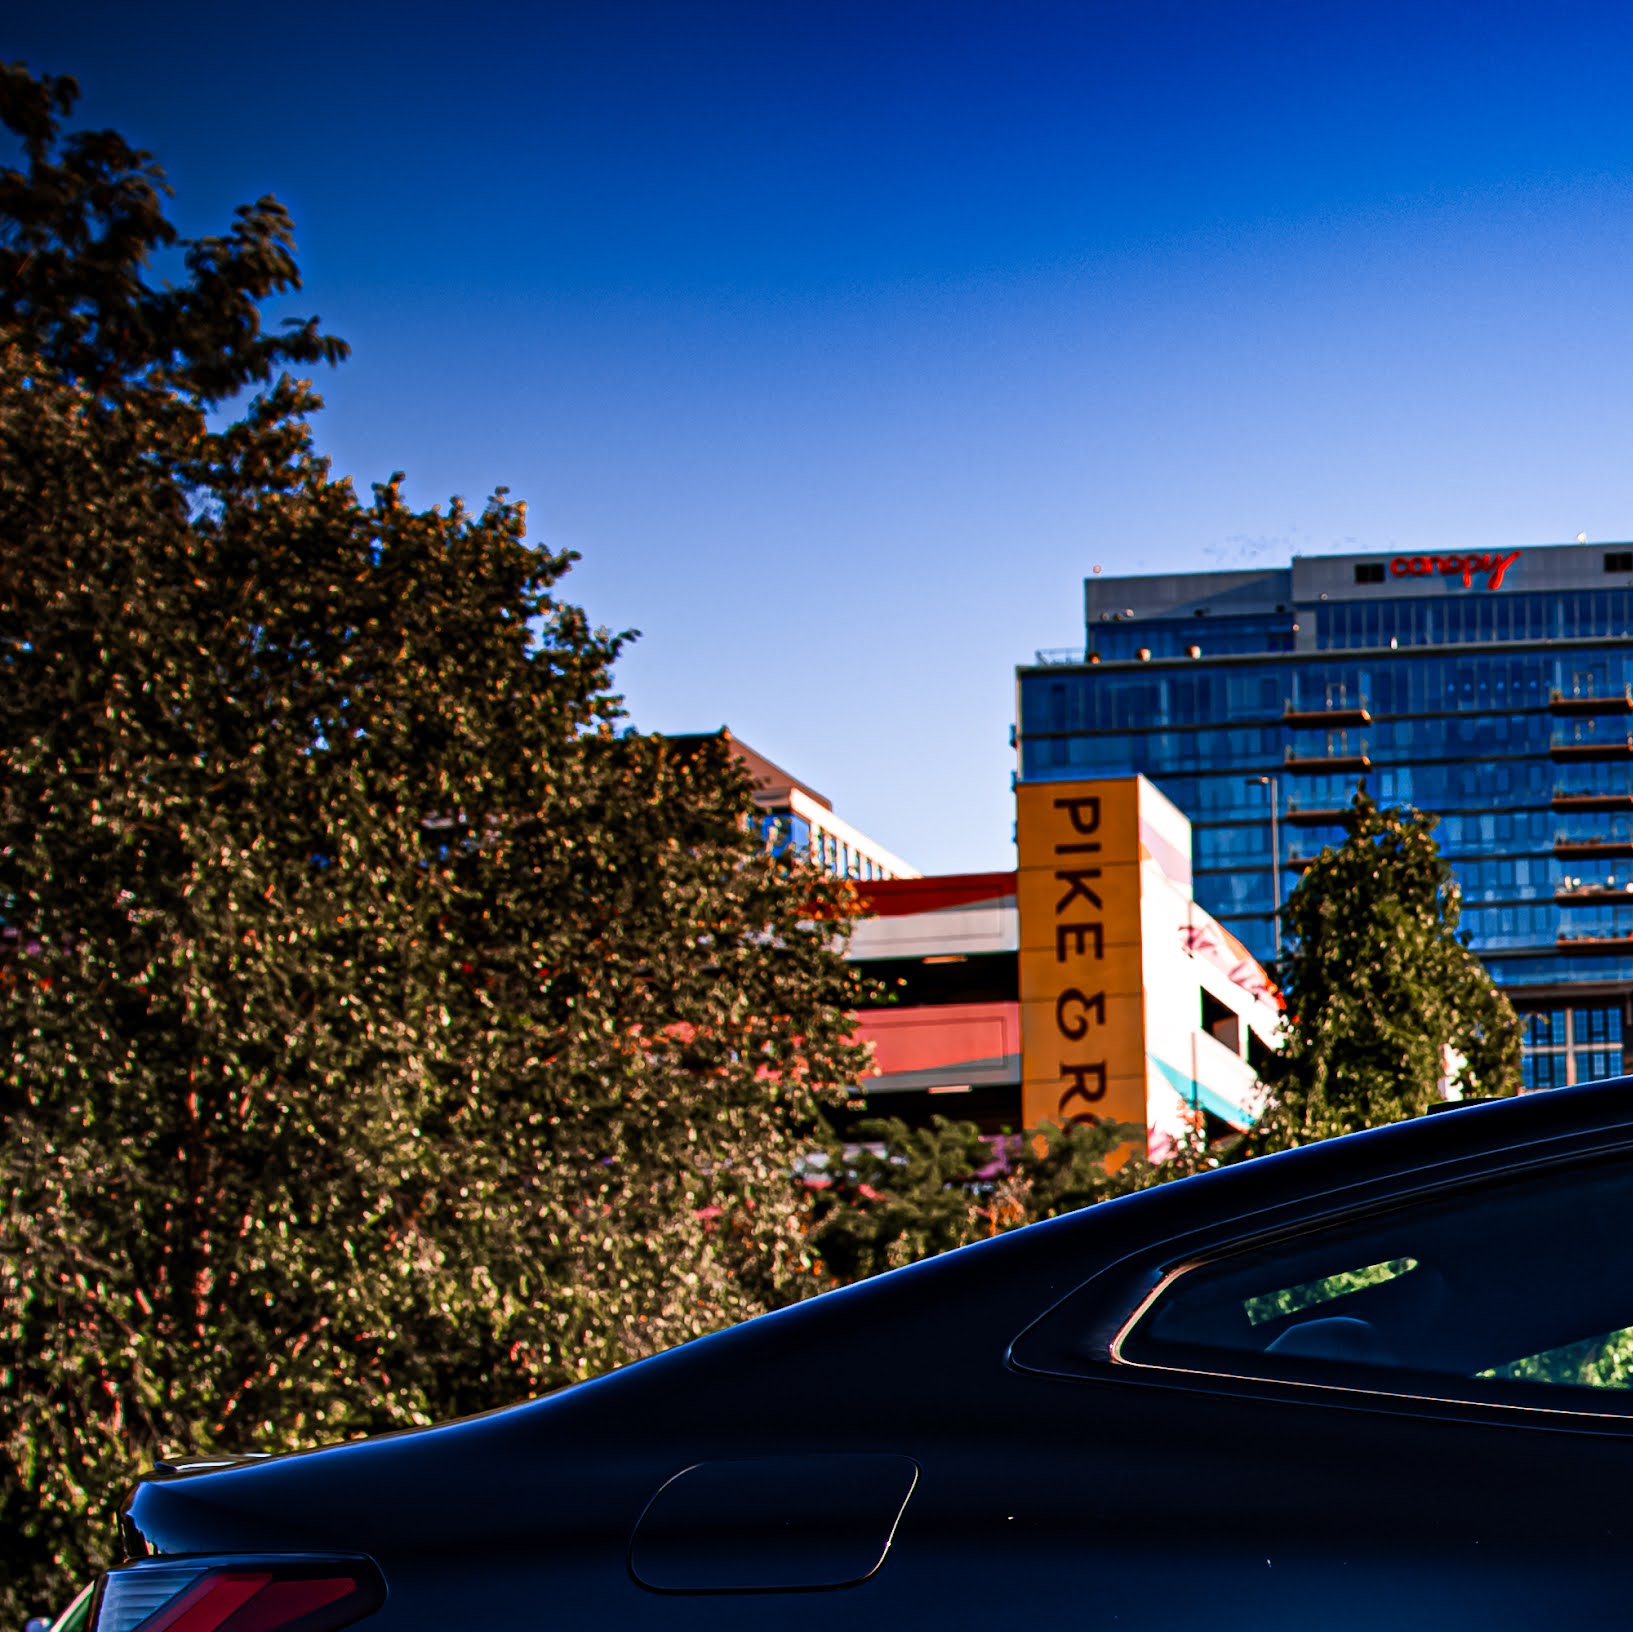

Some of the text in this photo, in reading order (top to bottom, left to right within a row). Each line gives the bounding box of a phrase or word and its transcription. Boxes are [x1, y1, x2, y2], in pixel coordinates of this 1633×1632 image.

[1389, 550, 1521, 591] canopy
[1053, 796, 1105, 963] PIKE
[1055, 987, 1107, 1042] &
